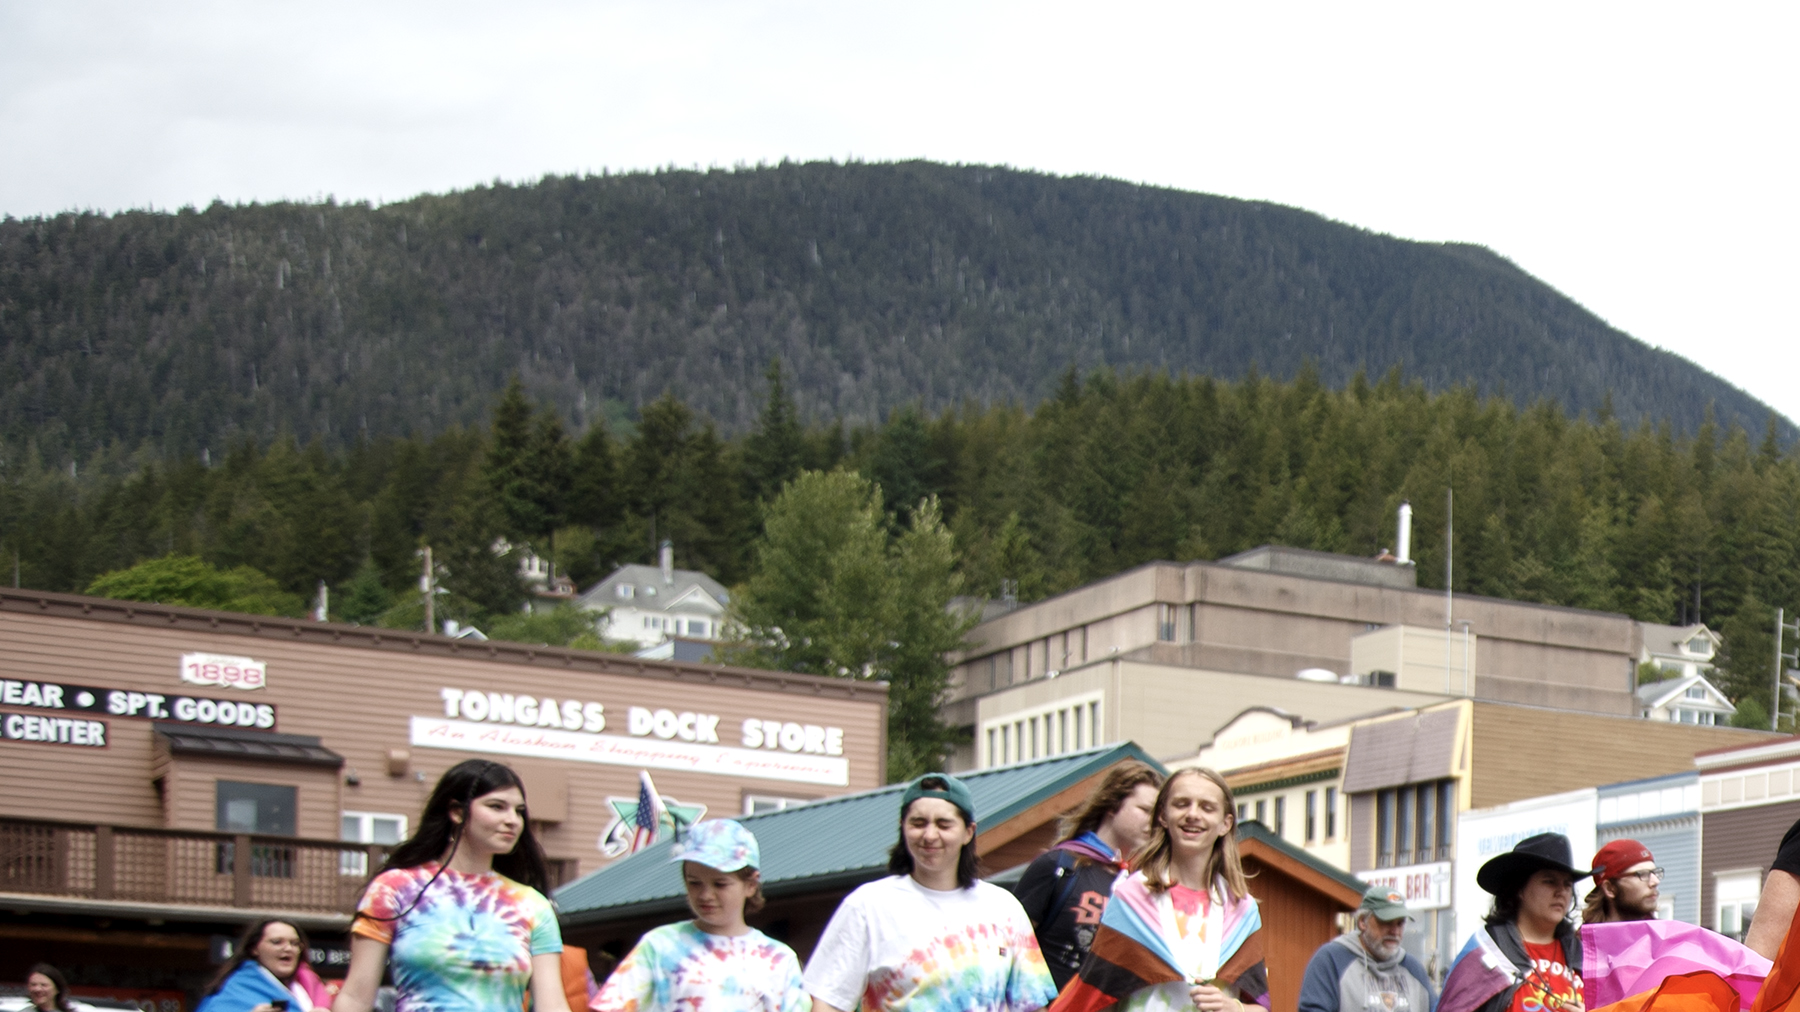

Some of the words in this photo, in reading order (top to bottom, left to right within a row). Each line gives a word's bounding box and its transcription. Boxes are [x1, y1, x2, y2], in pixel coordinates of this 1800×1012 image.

[188, 663, 262, 685] 1898
[0, 680, 65, 708] EAR
[107, 690, 170, 719] SPT.
[174, 697, 275, 729] GOODS
[7, 715, 106, 747] CENTER
[441, 687, 606, 733] TONGASS
[628, 706, 720, 743] DOCK
[741, 717, 844, 756] STORE
[1405, 872, 1432, 900] BAR
